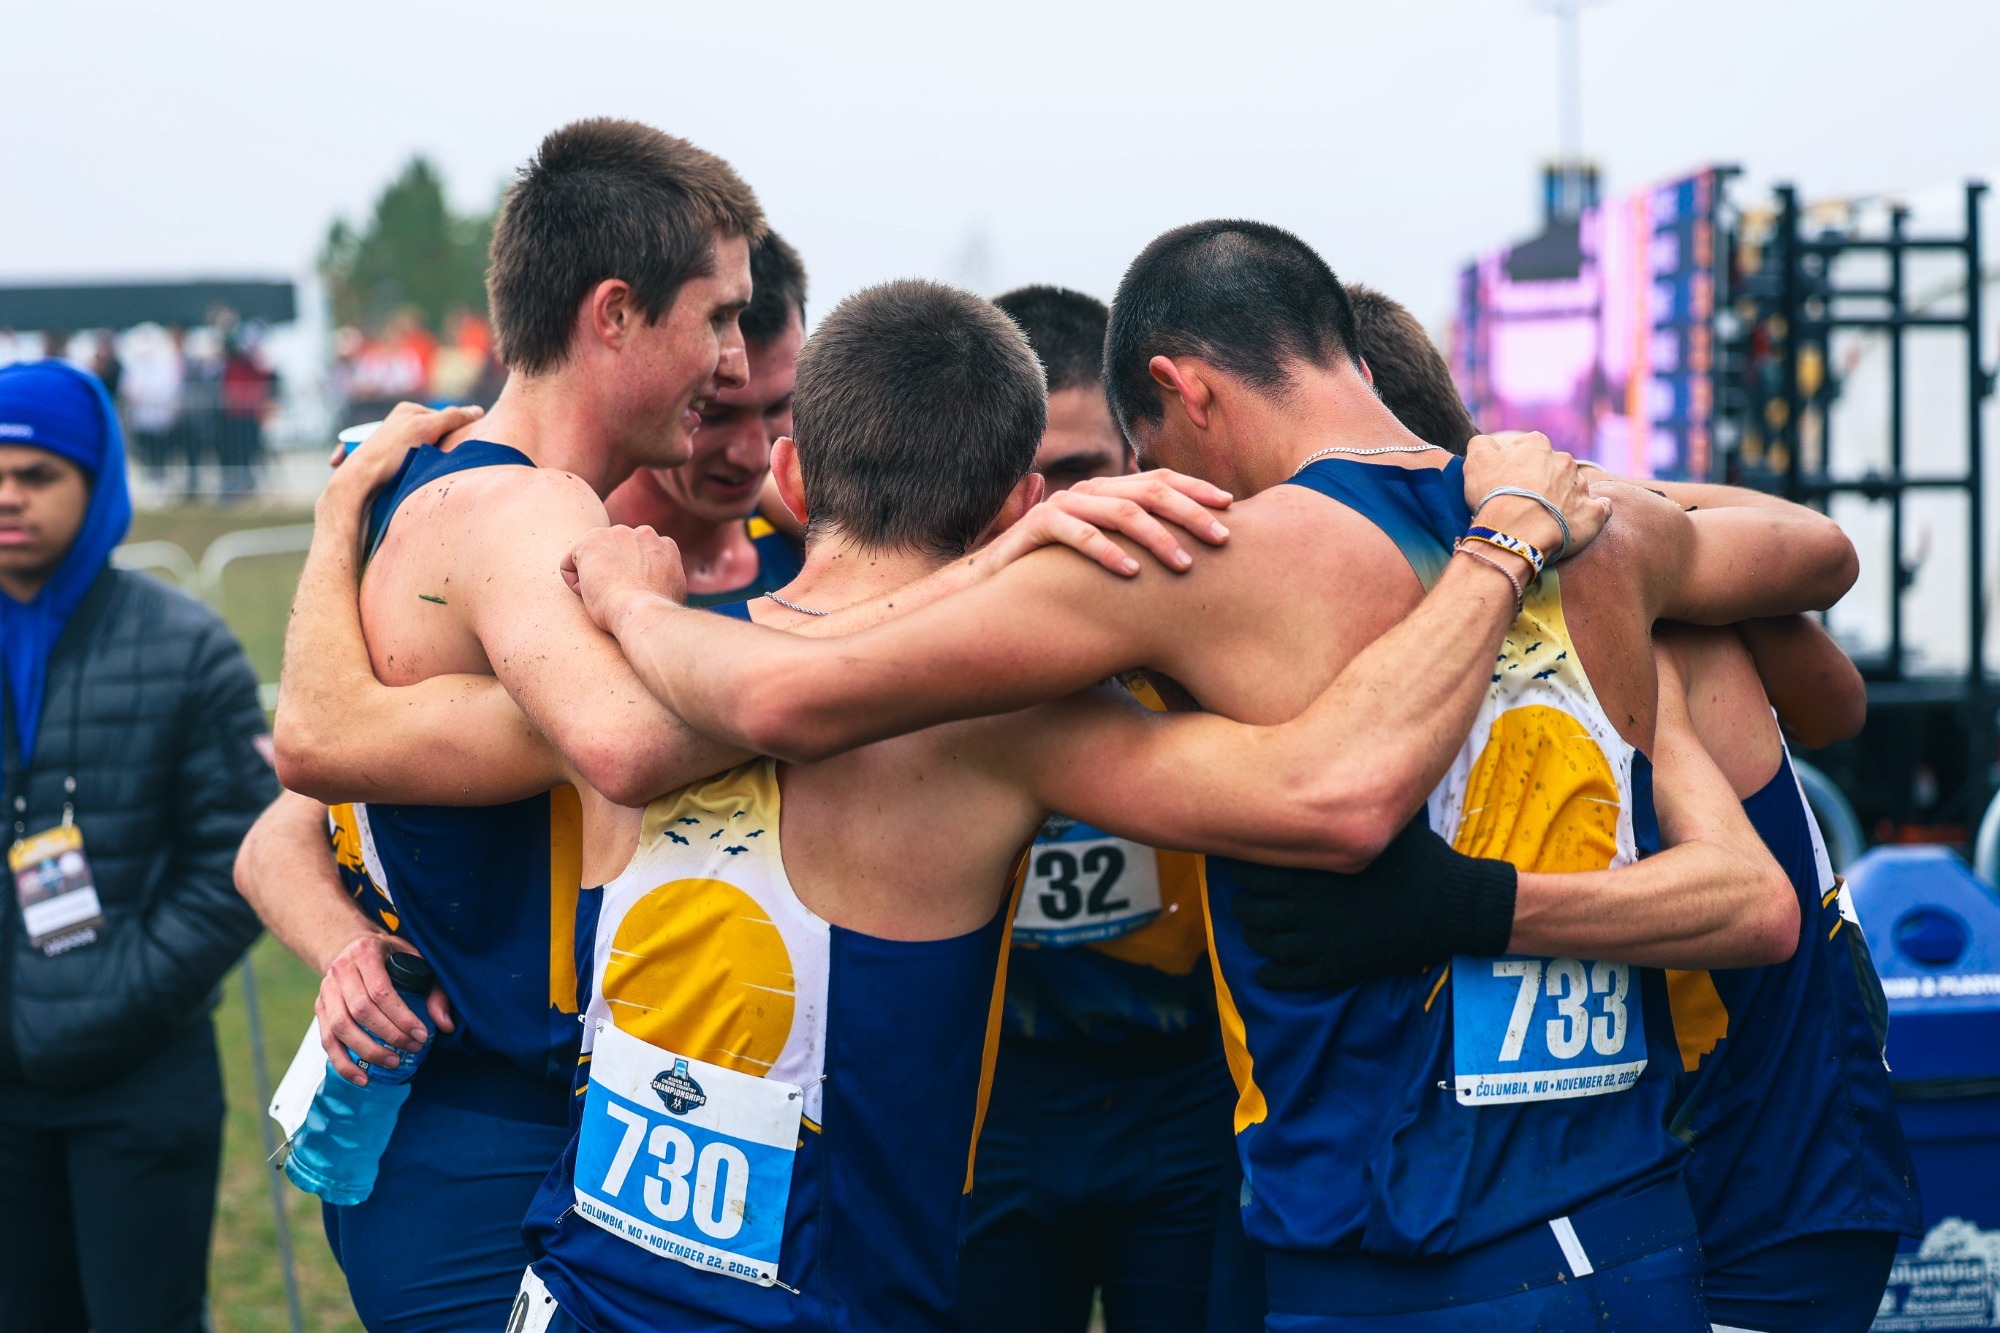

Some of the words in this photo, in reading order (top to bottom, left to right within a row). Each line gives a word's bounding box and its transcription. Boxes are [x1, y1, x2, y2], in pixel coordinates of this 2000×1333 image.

[1034, 845, 1131, 921] 32
[1492, 957, 1630, 1062] 733
[358, 1060, 369, 1070] 130
[652, 1080, 706, 1105] CHAMPIONSHIPS
[1476, 1081, 1530, 1098] COLUMBIA,
[1533, 1080, 1549, 1094] MO
[1555, 1074, 1603, 1092] NOVEMBER
[1603, 1073, 1616, 1087] 22,
[1618, 1070, 1639, 1085] 2025
[601, 1100, 749, 1240] 730
[581, 1201, 625, 1234] COLUMBIA,
[627, 1224, 643, 1240] MO
[649, 1234, 705, 1263] NOVEMBER
[706, 1255, 725, 1271] 22,
[728, 1261, 759, 1279] 2025
